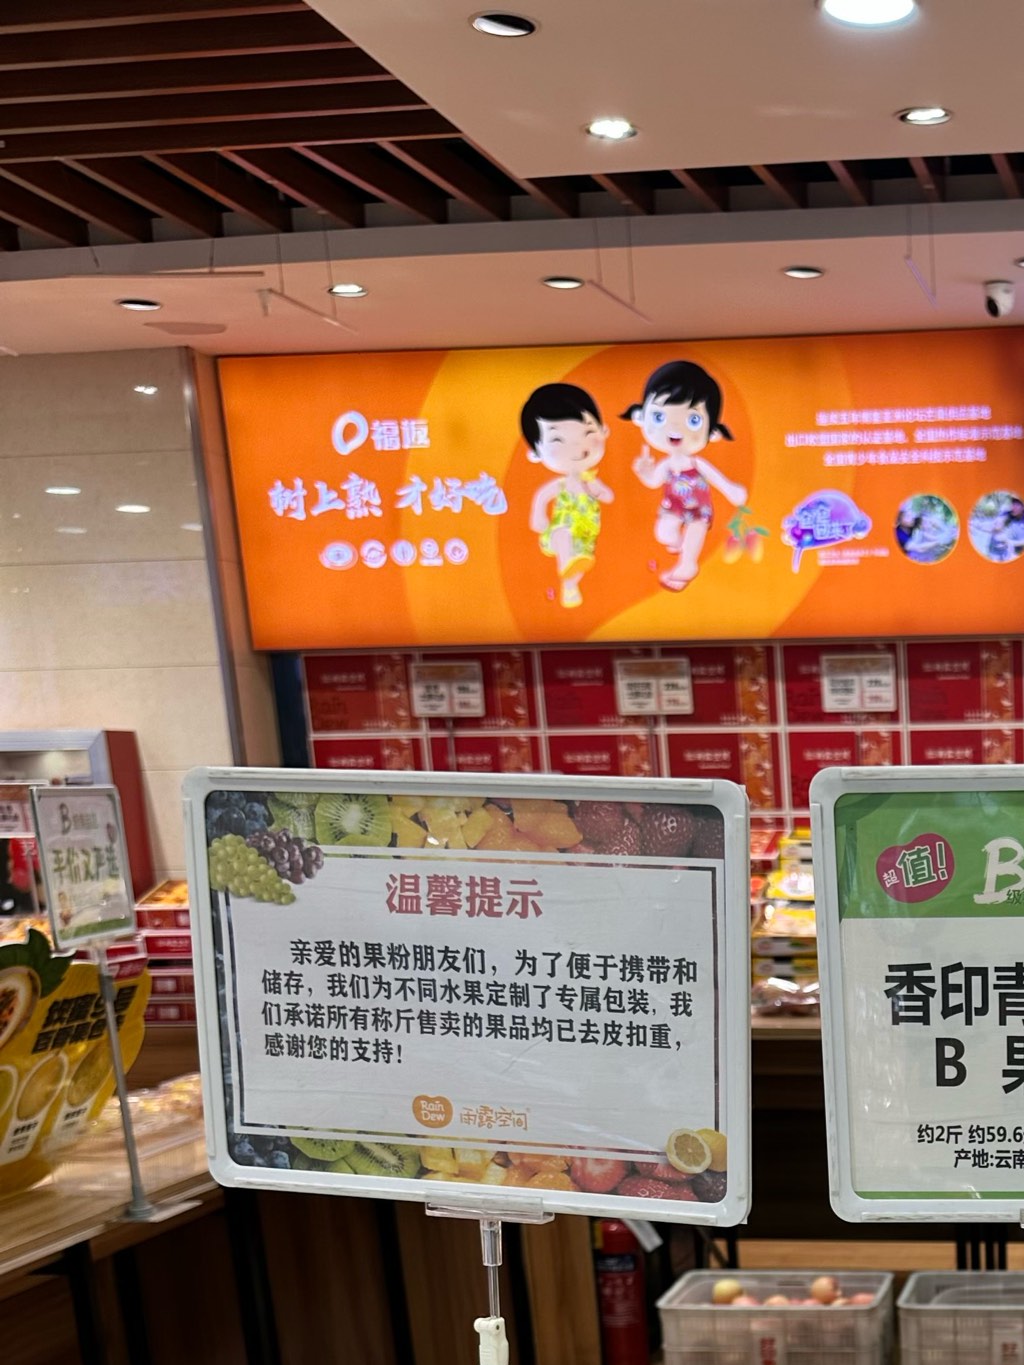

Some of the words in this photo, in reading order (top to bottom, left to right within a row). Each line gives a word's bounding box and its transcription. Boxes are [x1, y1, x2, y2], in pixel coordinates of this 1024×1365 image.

[267, 472, 383, 520] 树上熟
[395, 472, 509, 515] 才好吃
[385, 873, 544, 919] 温馨提示
[290, 939, 698, 985] 亲爱的果粉朋友们，为了便于携带和
[264, 1032, 404, 1065] 感谢您的支持！
[936, 1038, 967, 1088] B
[420, 1099, 445, 1111] Rain
[421, 1110, 446, 1123] Dew
[917, 1125, 963, 1145] 约2斤
